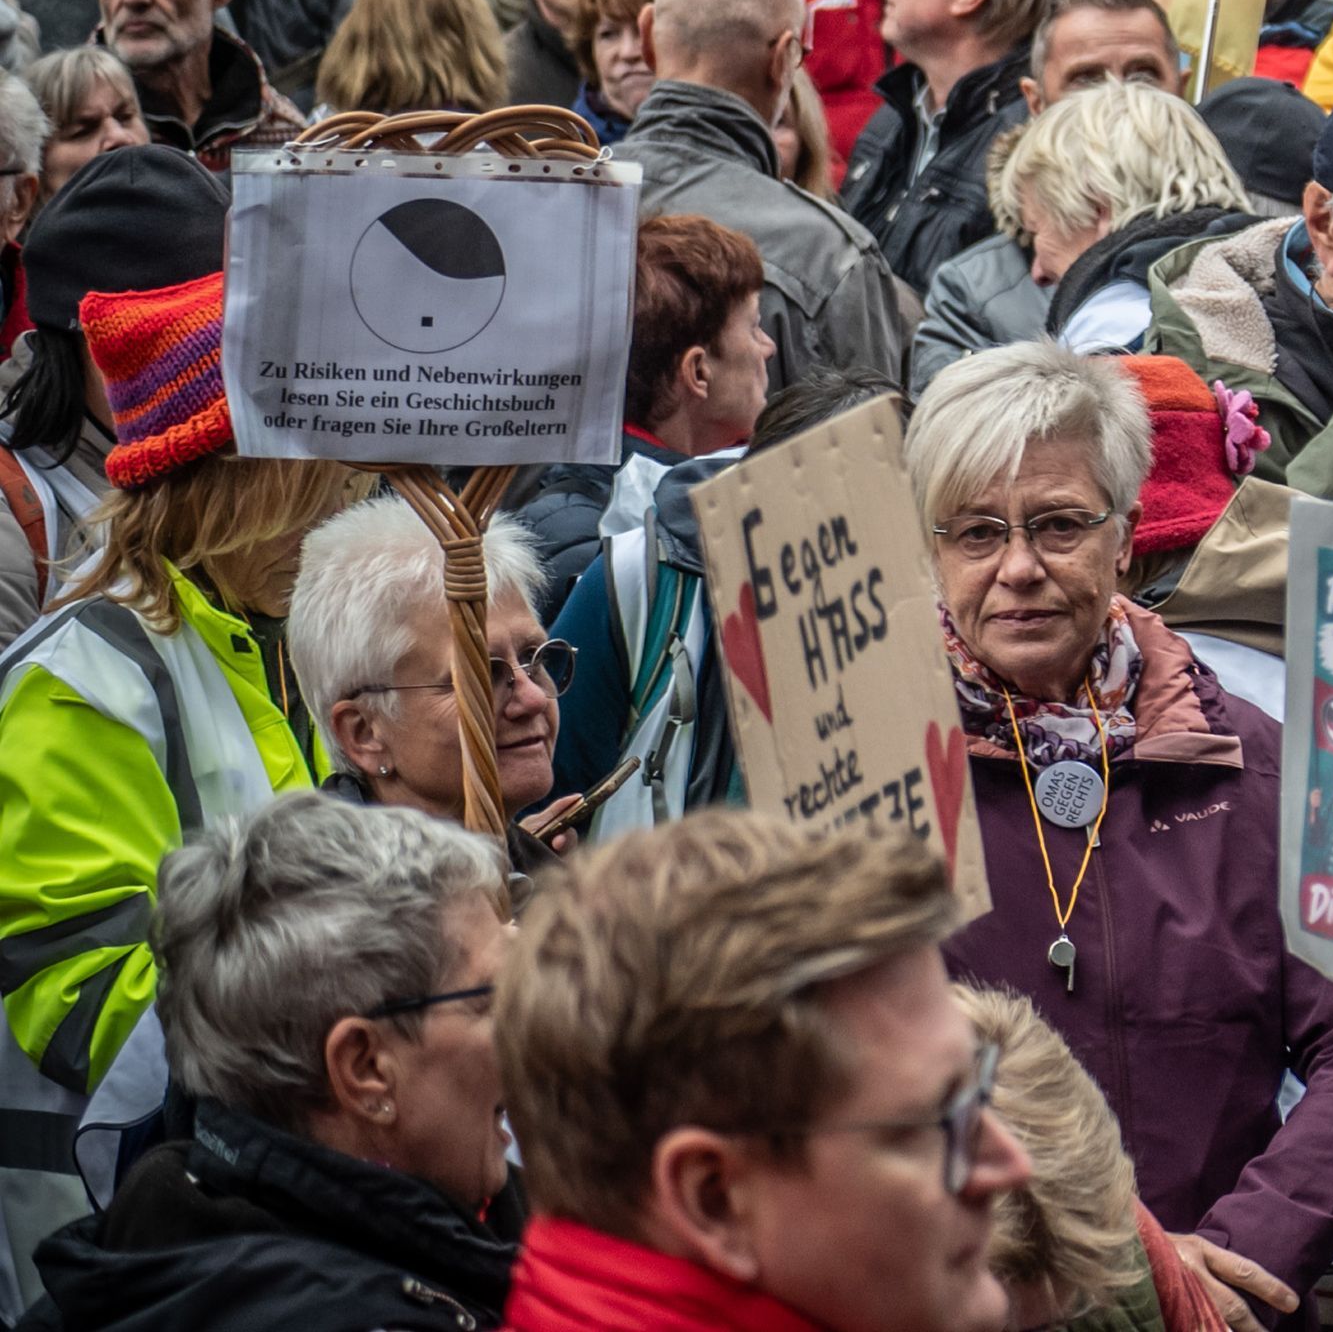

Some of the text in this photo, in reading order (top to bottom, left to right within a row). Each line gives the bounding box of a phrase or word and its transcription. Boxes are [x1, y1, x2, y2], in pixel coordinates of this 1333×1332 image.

[260, 361, 582, 390] Zu Risiken und Nebenwirkungen
[280, 388, 555, 412] lesen Sie ein Geschichtsbuch
[264, 412, 567, 437] oder fragen Sie Ihre Großeltern
[742, 507, 858, 621] Gegen
[799, 566, 889, 692] HASS
[814, 681, 853, 741] und
[783, 747, 863, 824] rechte
[1042, 770, 1066, 808] OMAS
[1053, 772, 1079, 817] GEGEN
[1065, 776, 1095, 824] RECHTS
[1174, 801, 1232, 823] VAUDE
